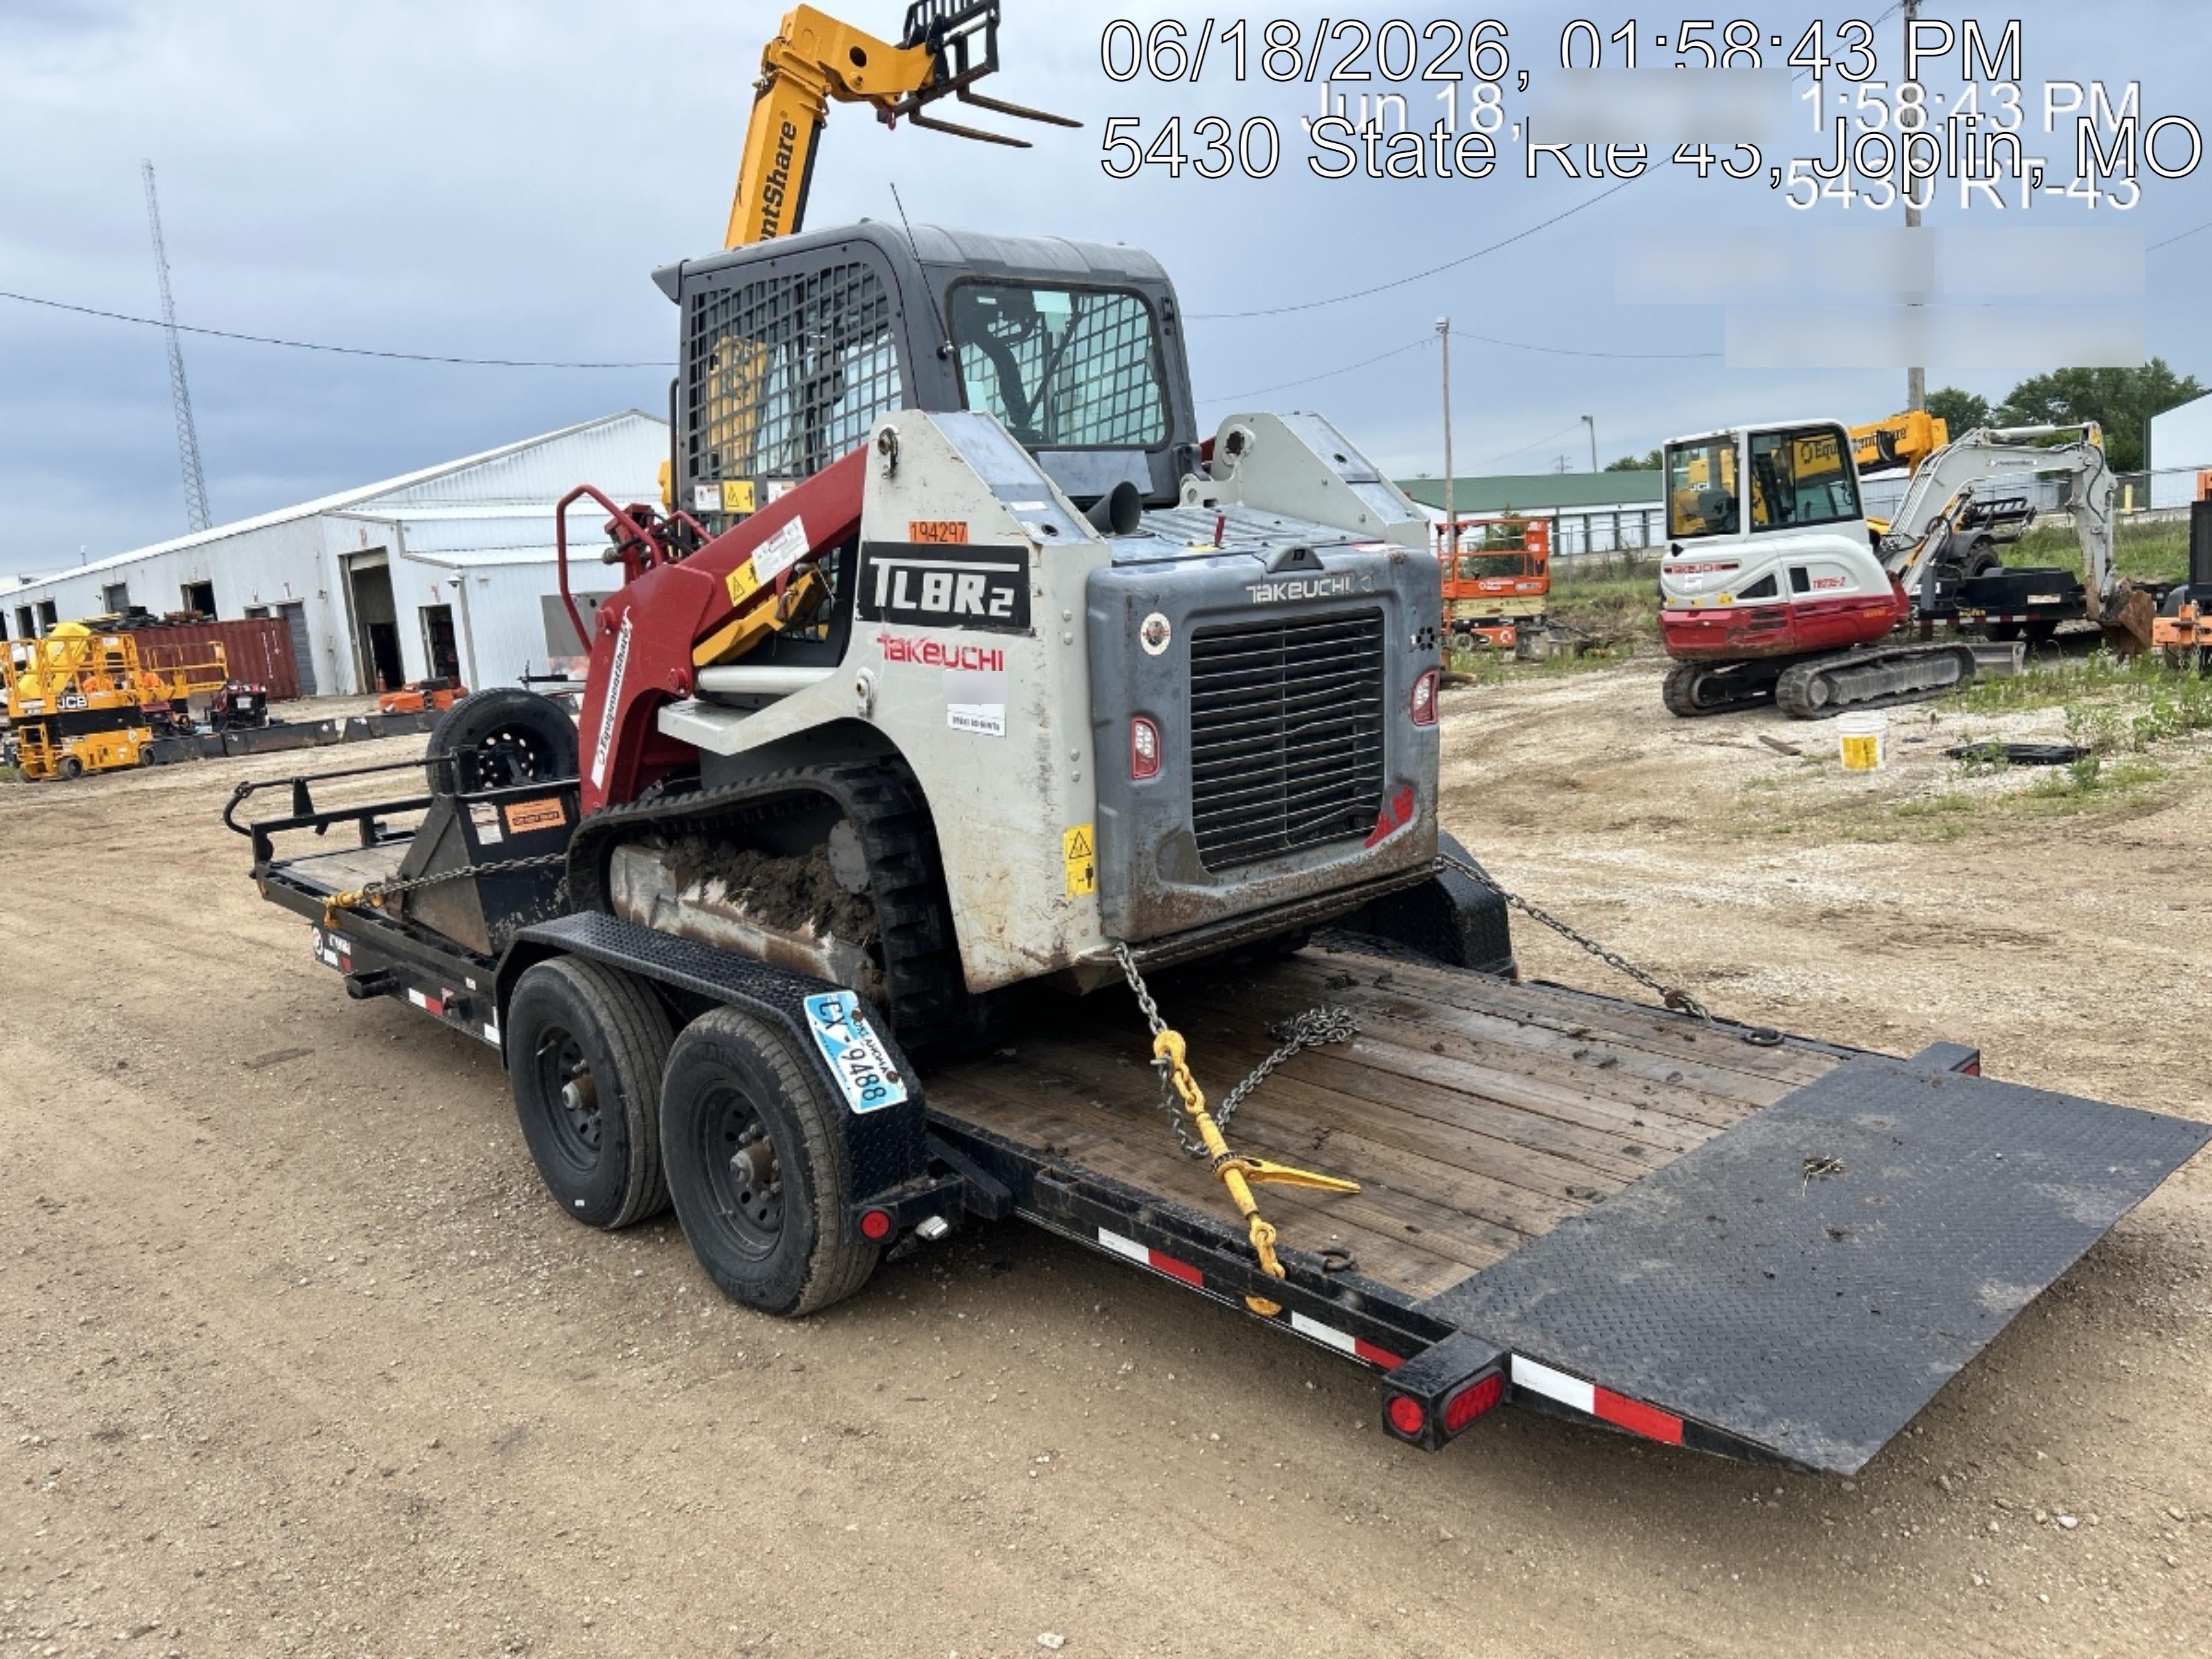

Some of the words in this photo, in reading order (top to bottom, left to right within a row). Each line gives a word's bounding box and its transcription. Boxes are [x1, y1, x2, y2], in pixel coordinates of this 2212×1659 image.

[759, 121, 797, 241] ntShare
[910, 520, 967, 543] 194297
[869, 557, 1020, 618] TL8R2
[57, 695, 88, 708] JCB
